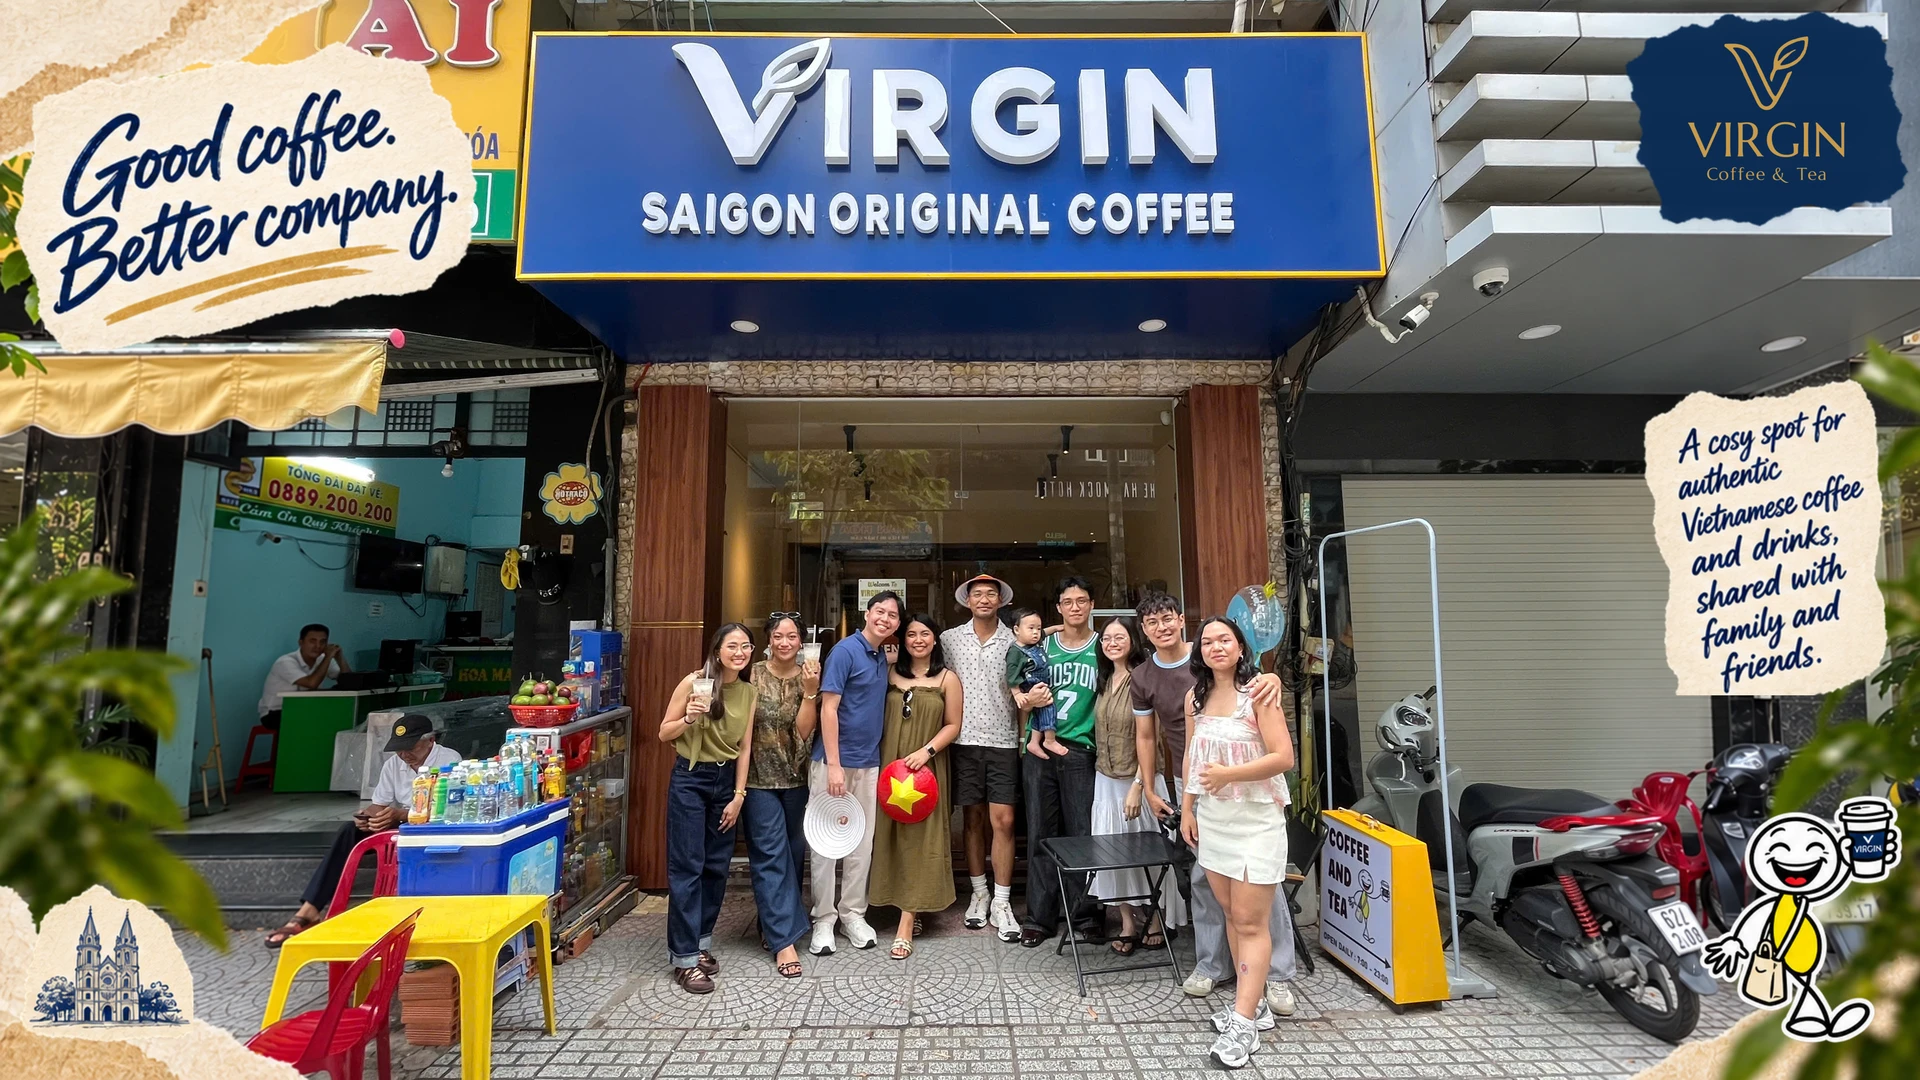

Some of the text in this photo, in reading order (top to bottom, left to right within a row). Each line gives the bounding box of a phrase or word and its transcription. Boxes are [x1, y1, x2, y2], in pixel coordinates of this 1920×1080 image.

[672, 37, 1218, 166] VIRGIN
[464, 126, 499, 160] ÓA
[642, 192, 1235, 236] SAIGON ORIGINAL COFFEE
[268, 479, 392, 523] 0889.200.200
[1057, 689, 1078, 720] 7
[1329, 827, 1370, 866] COFFEE
[1328, 858, 1352, 888] AND
[1327, 888, 1348, 920] TEA
[1323, 931, 1338, 947] OPEN
[1338, 941, 1354, 958] DAILY
